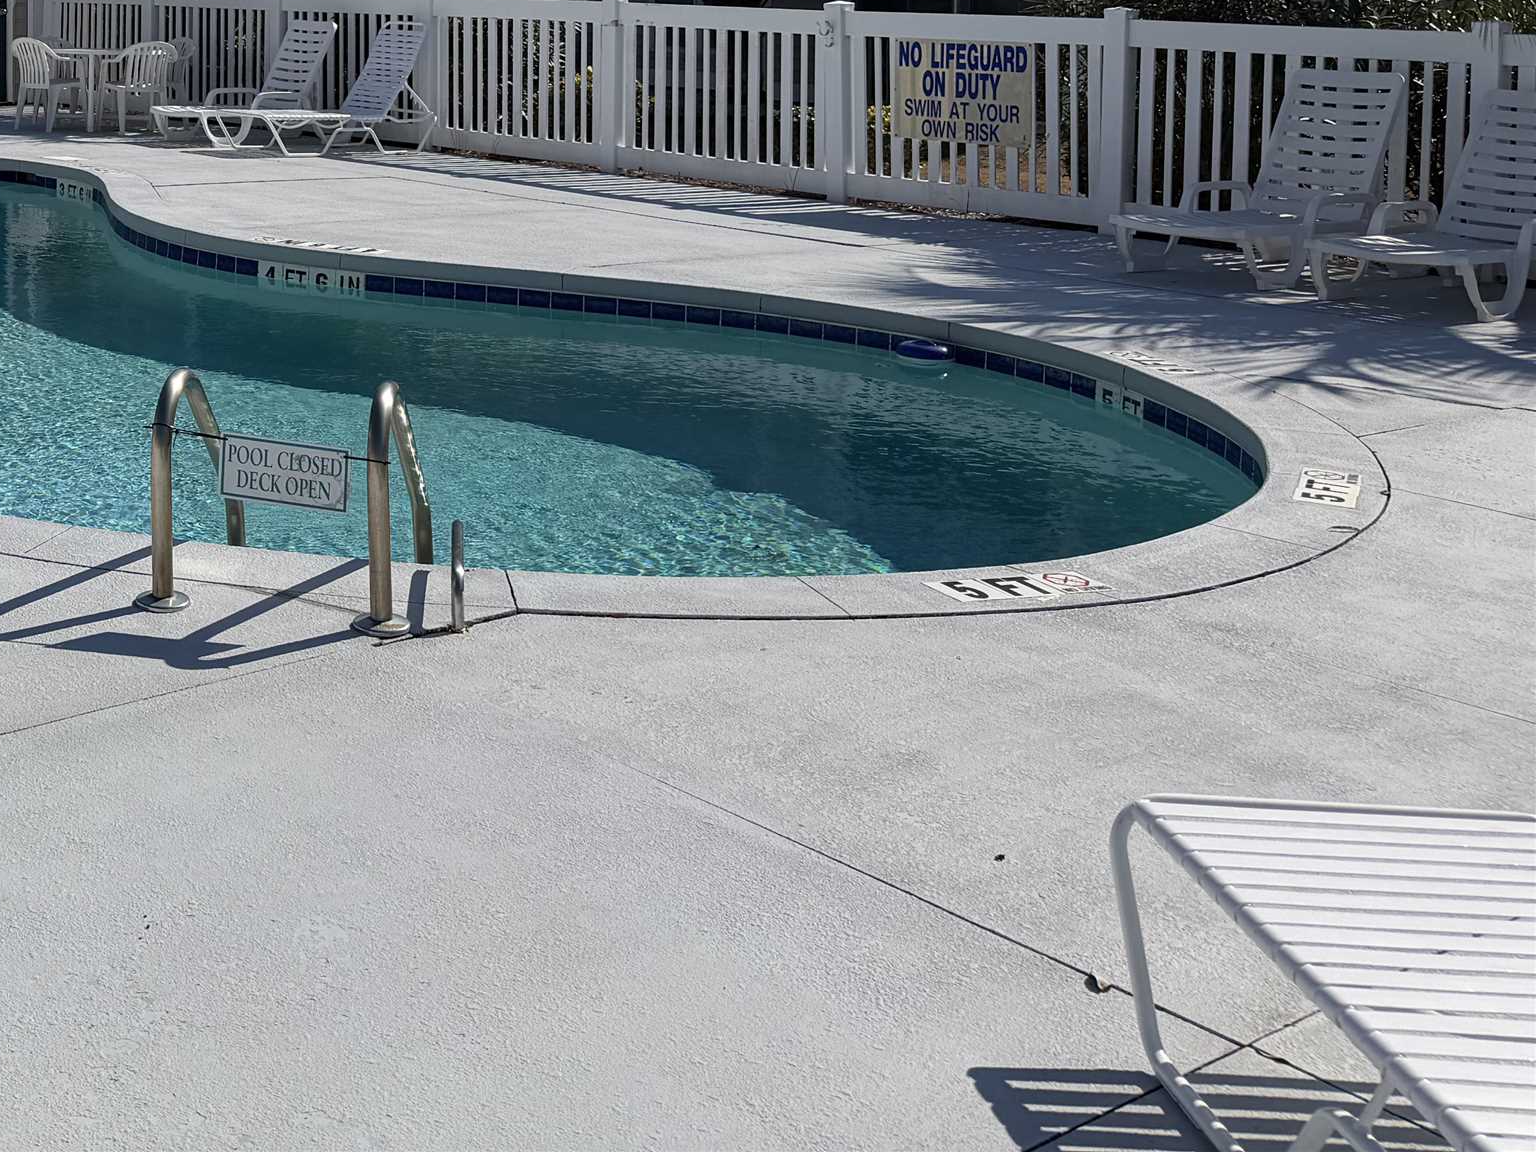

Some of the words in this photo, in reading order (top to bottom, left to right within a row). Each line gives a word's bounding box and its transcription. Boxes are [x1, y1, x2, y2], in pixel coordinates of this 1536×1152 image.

[899, 41, 922, 67] NO
[931, 42, 1028, 73] LIFEGUARD
[922, 70, 946, 97] ON
[955, 72, 1001, 100] DUTY
[904, 98, 942, 118] SWIM
[949, 102, 969, 119] AT
[977, 103, 1020, 124] YOUR
[921, 119, 957, 140] OWN
[965, 122, 1000, 143] RISK
[265, 266, 275, 279] 4
[285, 269, 306, 283] FT
[340, 275, 360, 290] IN
[1102, 388, 1113, 405] 5
[1123, 396, 1141, 415] FT
[228, 444, 272, 468] POOL
[277, 451, 342, 478] CLOSED
[237, 469, 281, 494] DECK
[285, 476, 331, 501] OPEN
[941, 581, 989, 598] 5
[981, 576, 1052, 597] FT
